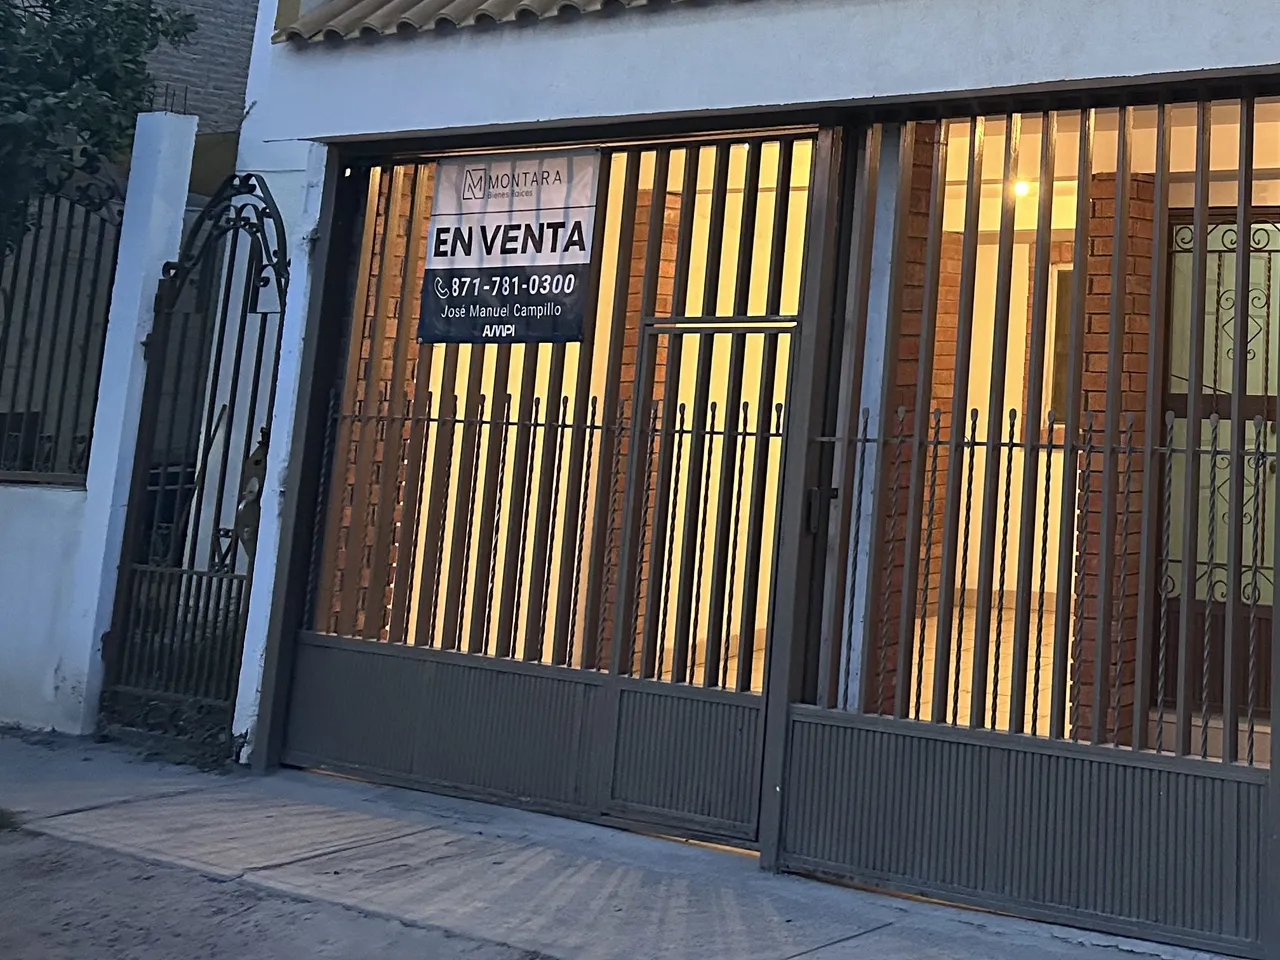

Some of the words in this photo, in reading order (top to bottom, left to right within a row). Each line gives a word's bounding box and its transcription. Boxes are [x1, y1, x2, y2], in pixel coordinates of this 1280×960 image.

[488, 170, 562, 189] MONTARA
[487, 191, 510, 199] Bienes
[433, 226, 473, 258] EN
[480, 221, 586, 256] VENTA
[451, 274, 575, 297] 871-781-0300
[441, 305, 466, 318] José
[469, 304, 510, 317] Manuel
[513, 302, 562, 319] Campillo
[482, 324, 515, 337] AMPI
